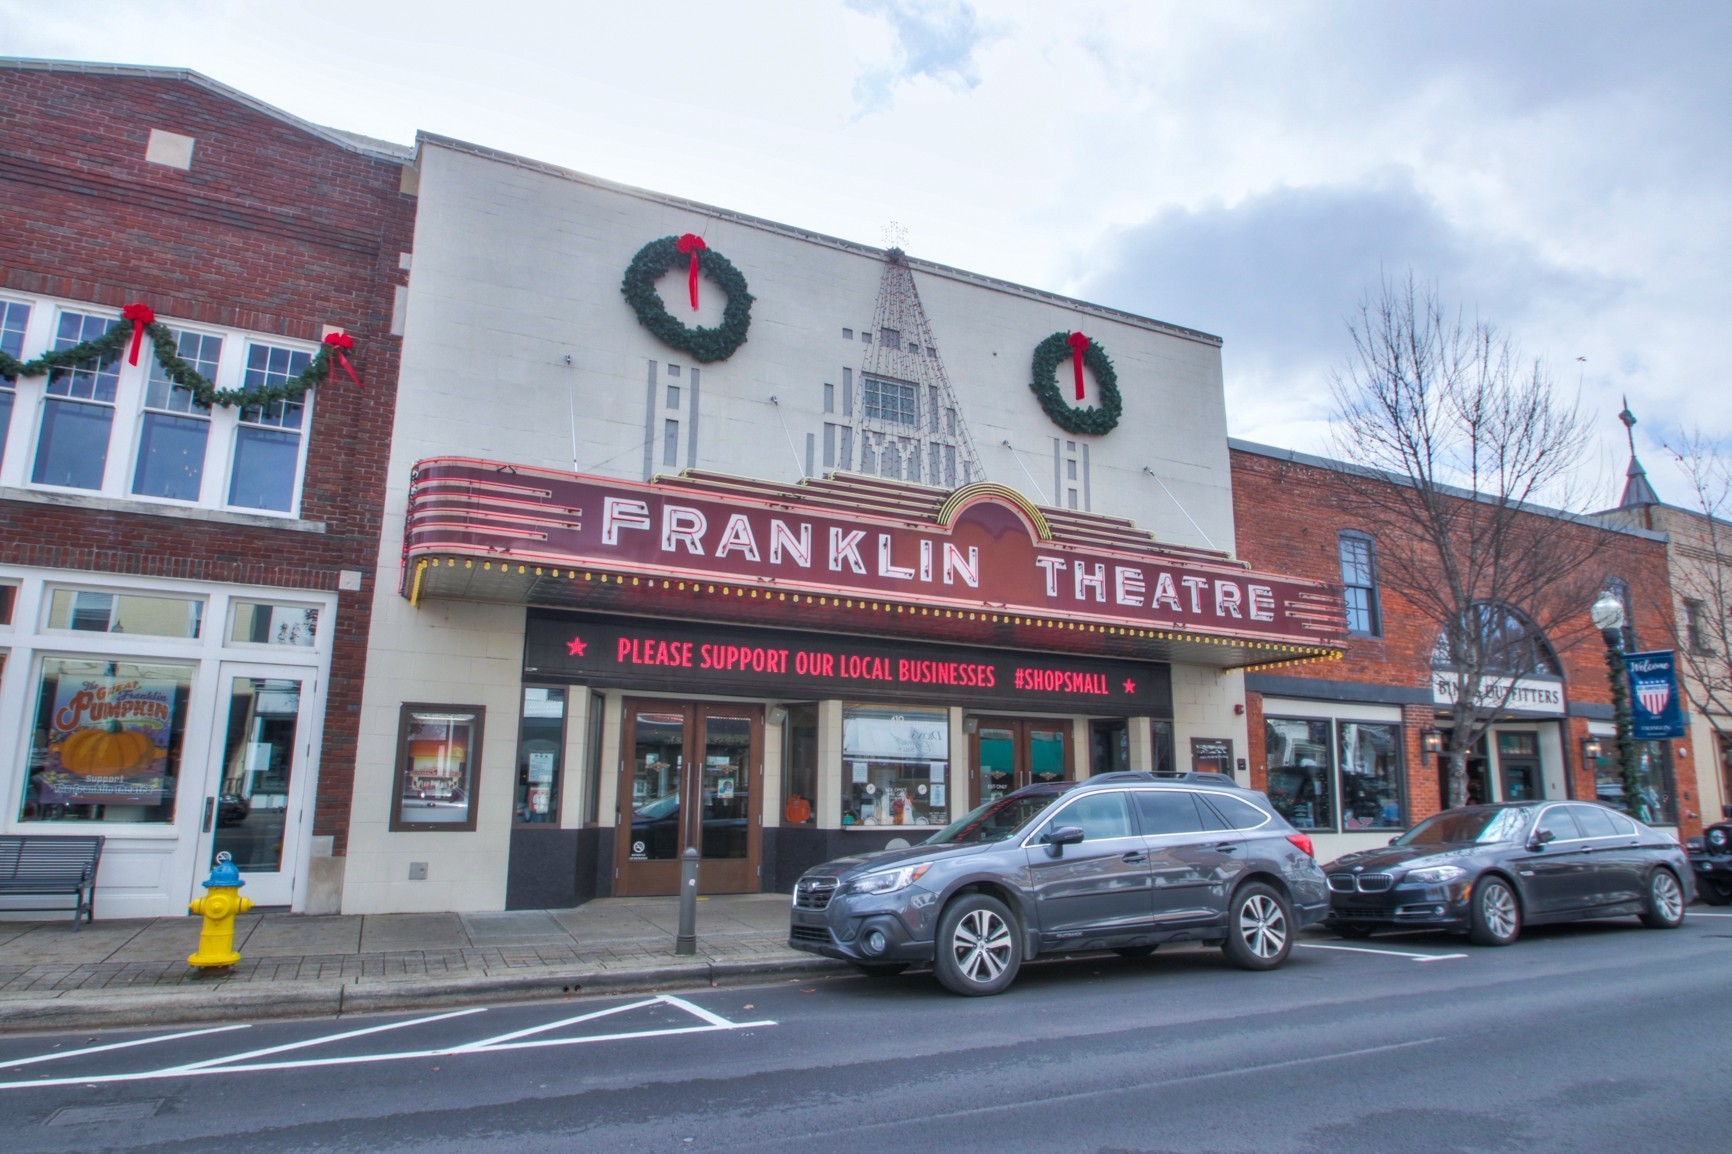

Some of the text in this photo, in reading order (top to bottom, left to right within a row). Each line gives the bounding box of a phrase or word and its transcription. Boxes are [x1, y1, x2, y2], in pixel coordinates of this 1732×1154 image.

[601, 496, 1274, 622] FRANKLIN THEATRE
[617, 637, 1109, 696] PLEASE SUPPORT OUR LOCAL BUSINESSES #SHOPSMALL
[1631, 660, 1670, 673] Welcome
[82, 680, 99, 691] The
[96, 680, 139, 700] GREAT
[1486, 685, 1559, 704] OUTFITTERS
[116, 689, 168, 702] Franklin
[56, 690, 169, 732] PUMPKIN
